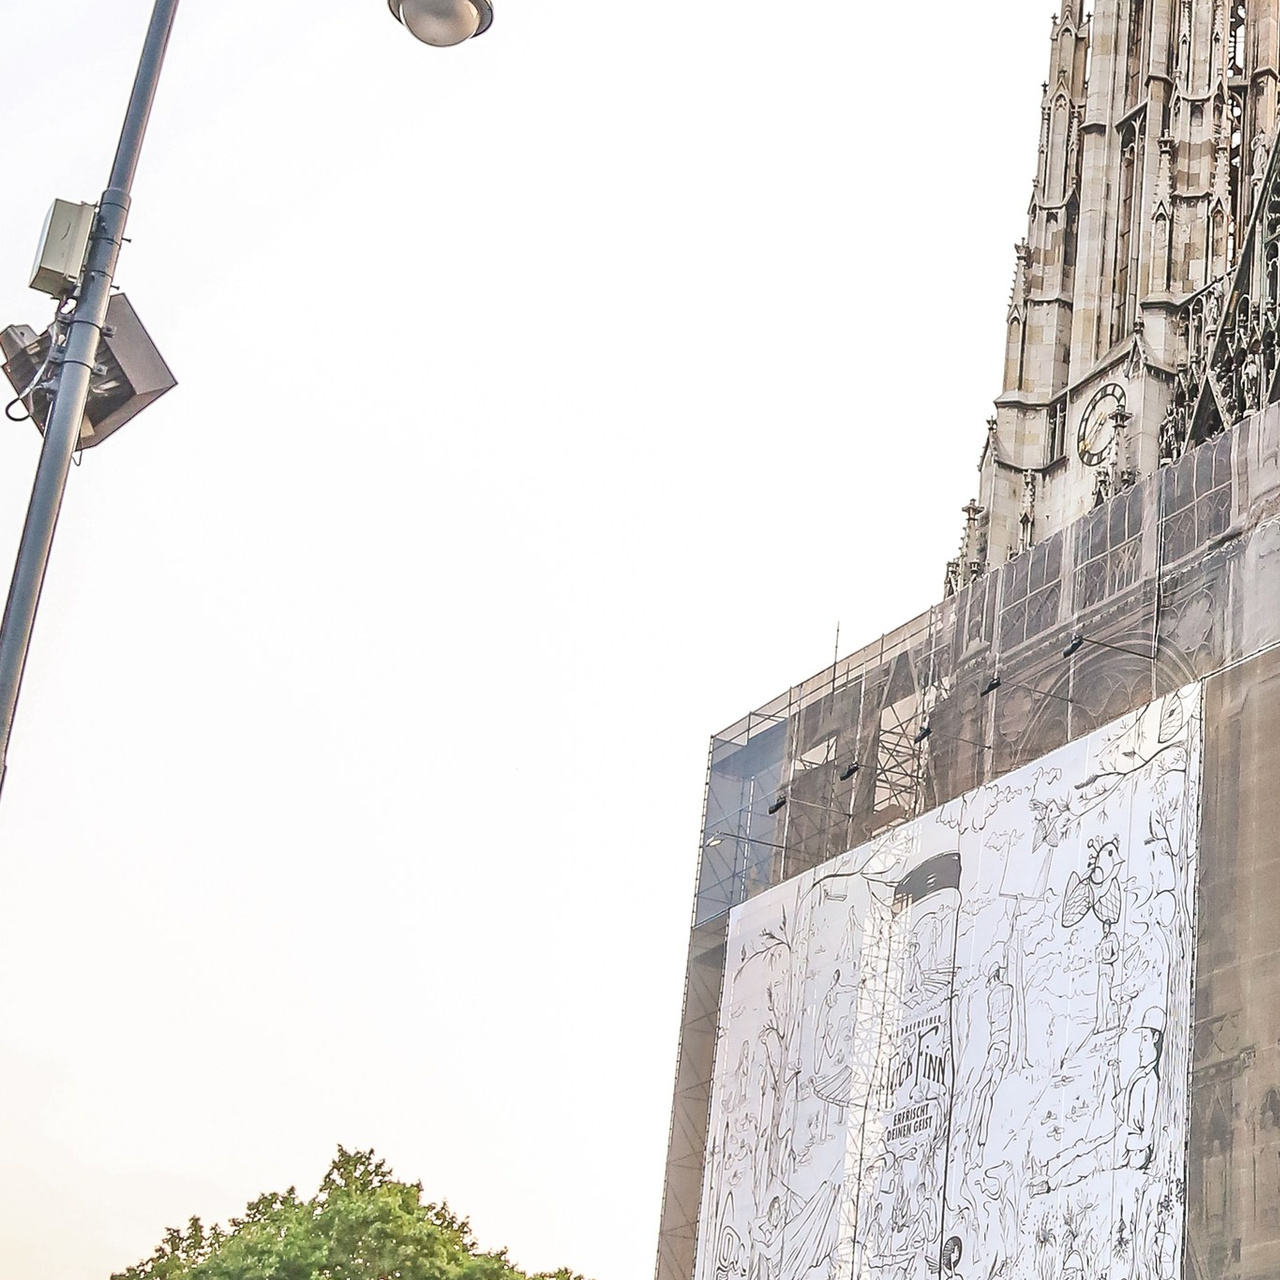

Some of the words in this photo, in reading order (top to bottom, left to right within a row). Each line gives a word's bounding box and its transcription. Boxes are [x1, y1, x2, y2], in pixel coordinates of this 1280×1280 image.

[893, 1103, 930, 1127] ERFRISCHT
[887, 1125, 912, 1142] DEINEN
[914, 1115, 933, 1133] GEIST
